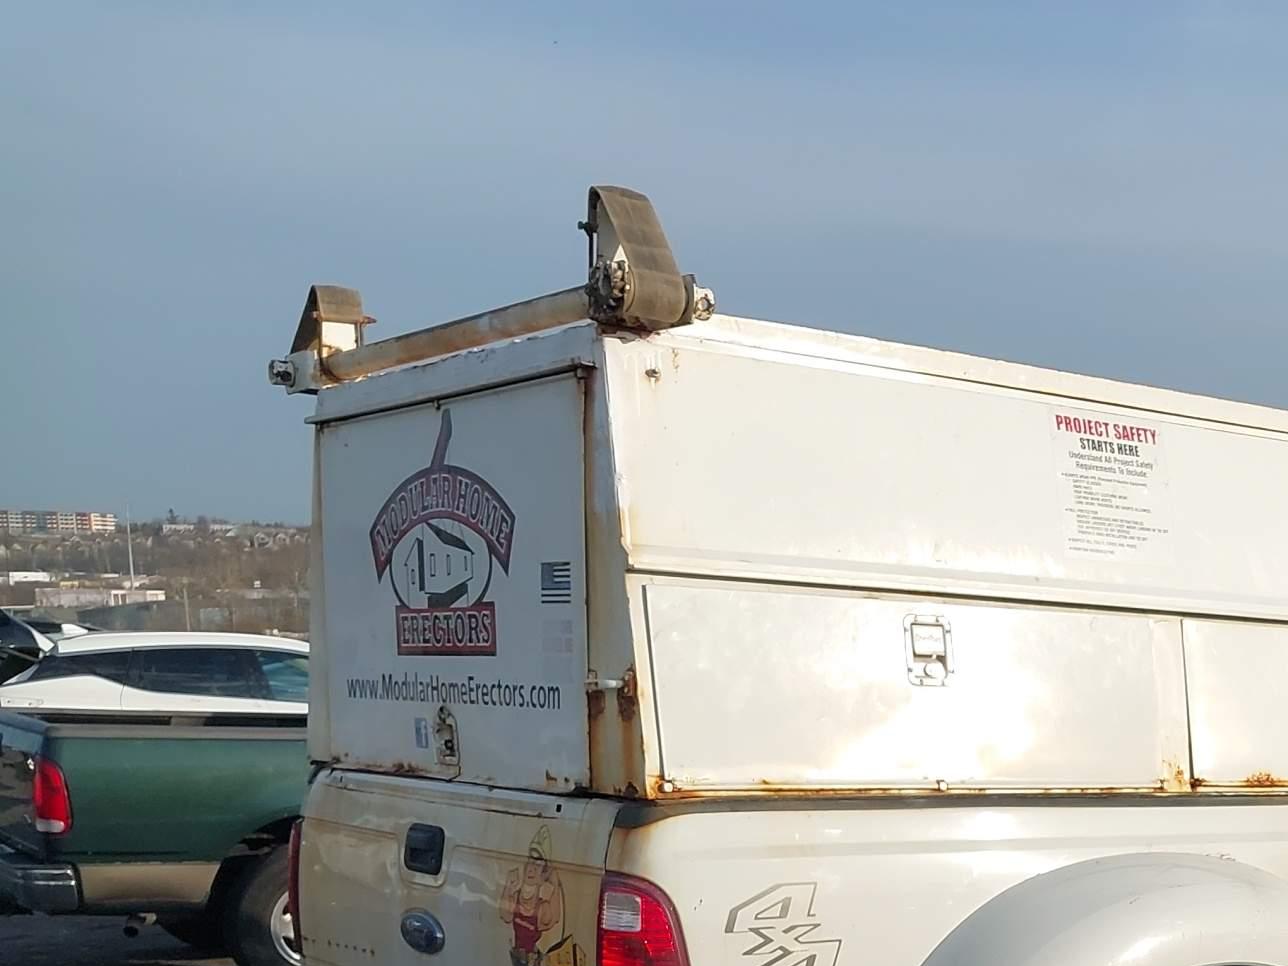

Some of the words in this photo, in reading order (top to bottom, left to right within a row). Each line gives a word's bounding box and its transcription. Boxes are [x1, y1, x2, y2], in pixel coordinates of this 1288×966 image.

[1055, 414, 1110, 438] PROJECT
[1113, 423, 1157, 445] SAFETY
[1079, 437, 1115, 454] STARTS
[1116, 442, 1140, 457] HERE
[375, 474, 452, 560] MODULAR
[454, 476, 511, 553] HOME
[400, 611, 491, 647] ERECTORS
[346, 672, 561, 710] www.ModularHomeErectors.com
